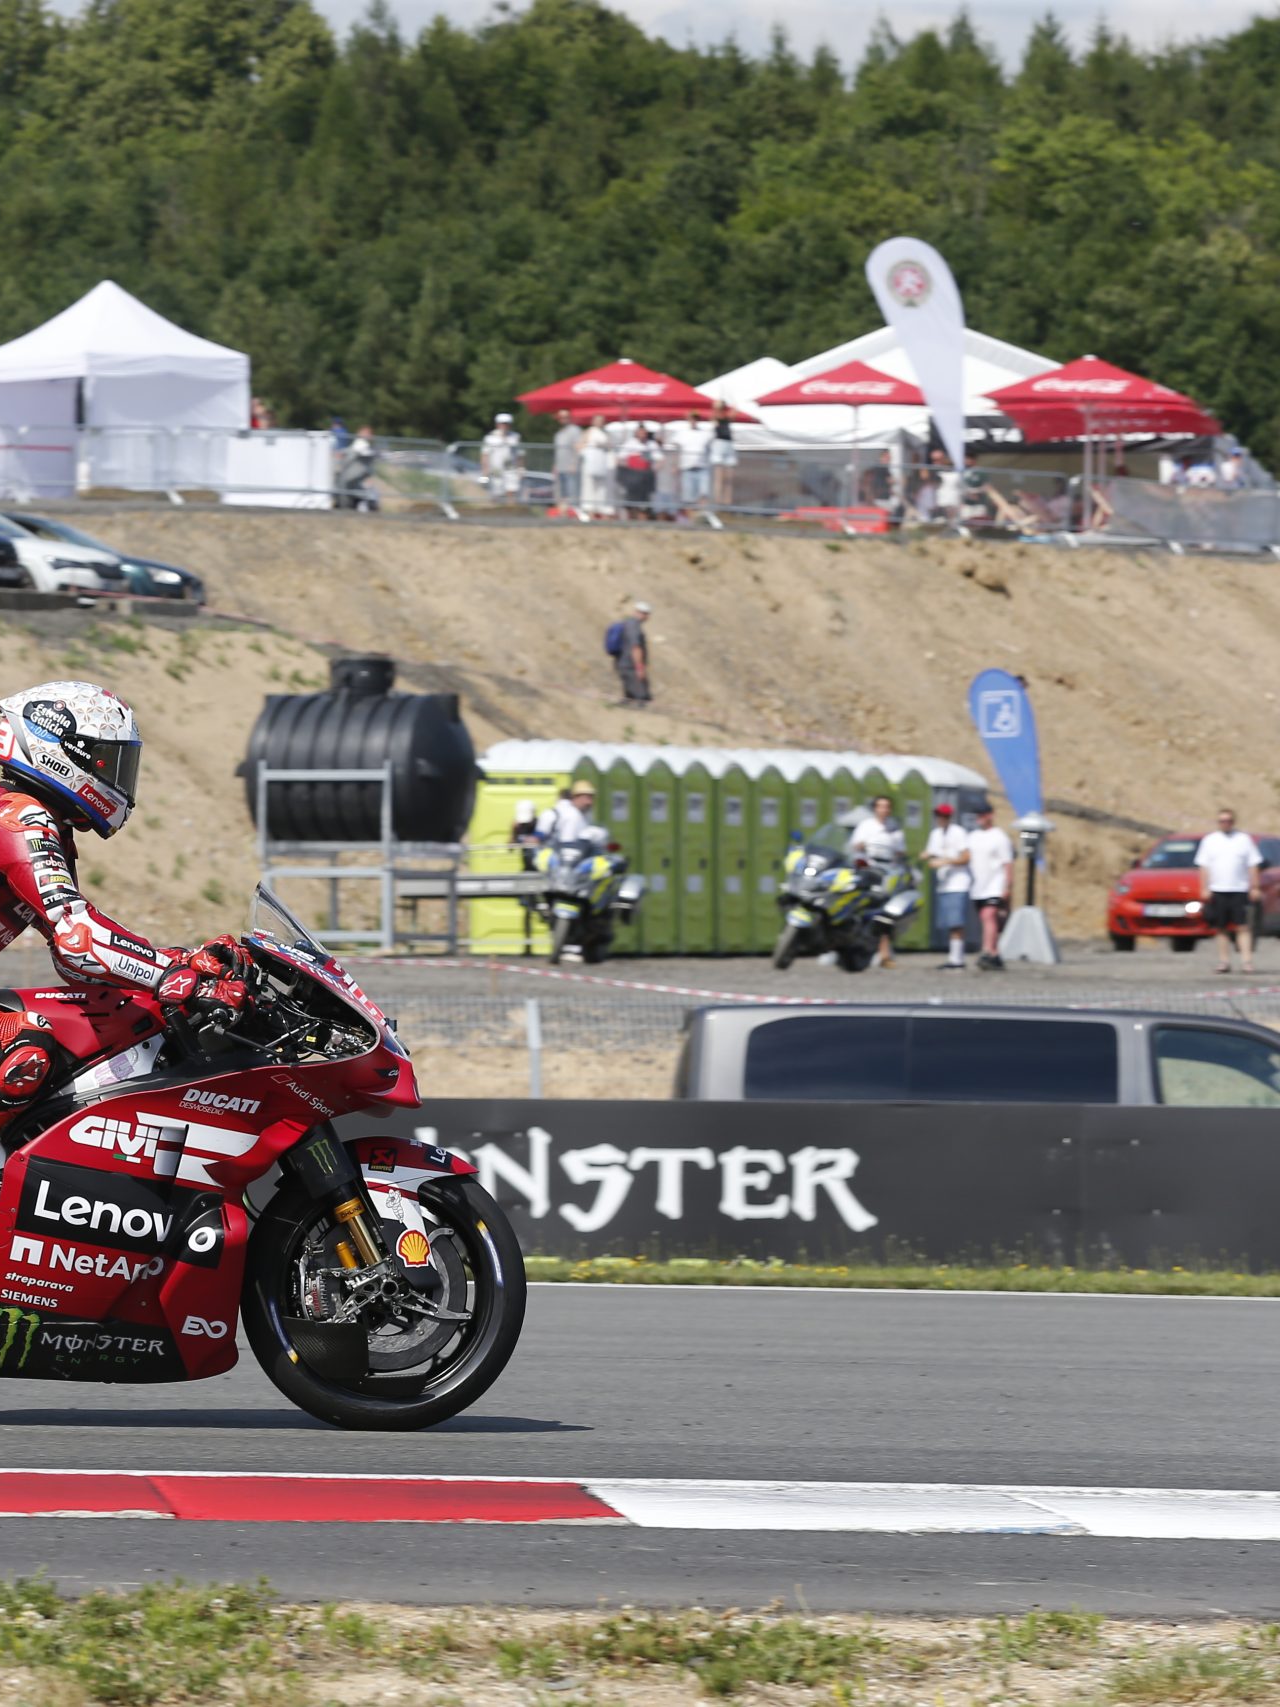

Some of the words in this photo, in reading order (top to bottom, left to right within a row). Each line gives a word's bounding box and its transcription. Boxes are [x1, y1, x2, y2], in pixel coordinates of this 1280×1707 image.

[30, 711, 64, 736] Galicia
[64, 740, 92, 760] verisure
[41, 754, 71, 777] SHOEI
[81, 787, 111, 815] Lenovo
[113, 935, 153, 958] Lenovo
[118, 956, 156, 984] Unipol
[178, 1100, 225, 1115] DESMOSEDICI
[183, 1088, 261, 1114] DUCATI
[286, 1080, 312, 1101] Audi
[308, 1097, 336, 1118] Sport
[69, 1115, 161, 1158] GIVI
[34, 1180, 217, 1253] Lenovo
[5, 1271, 74, 1292] streparava
[0, 1288, 58, 1308] SIEMENS
